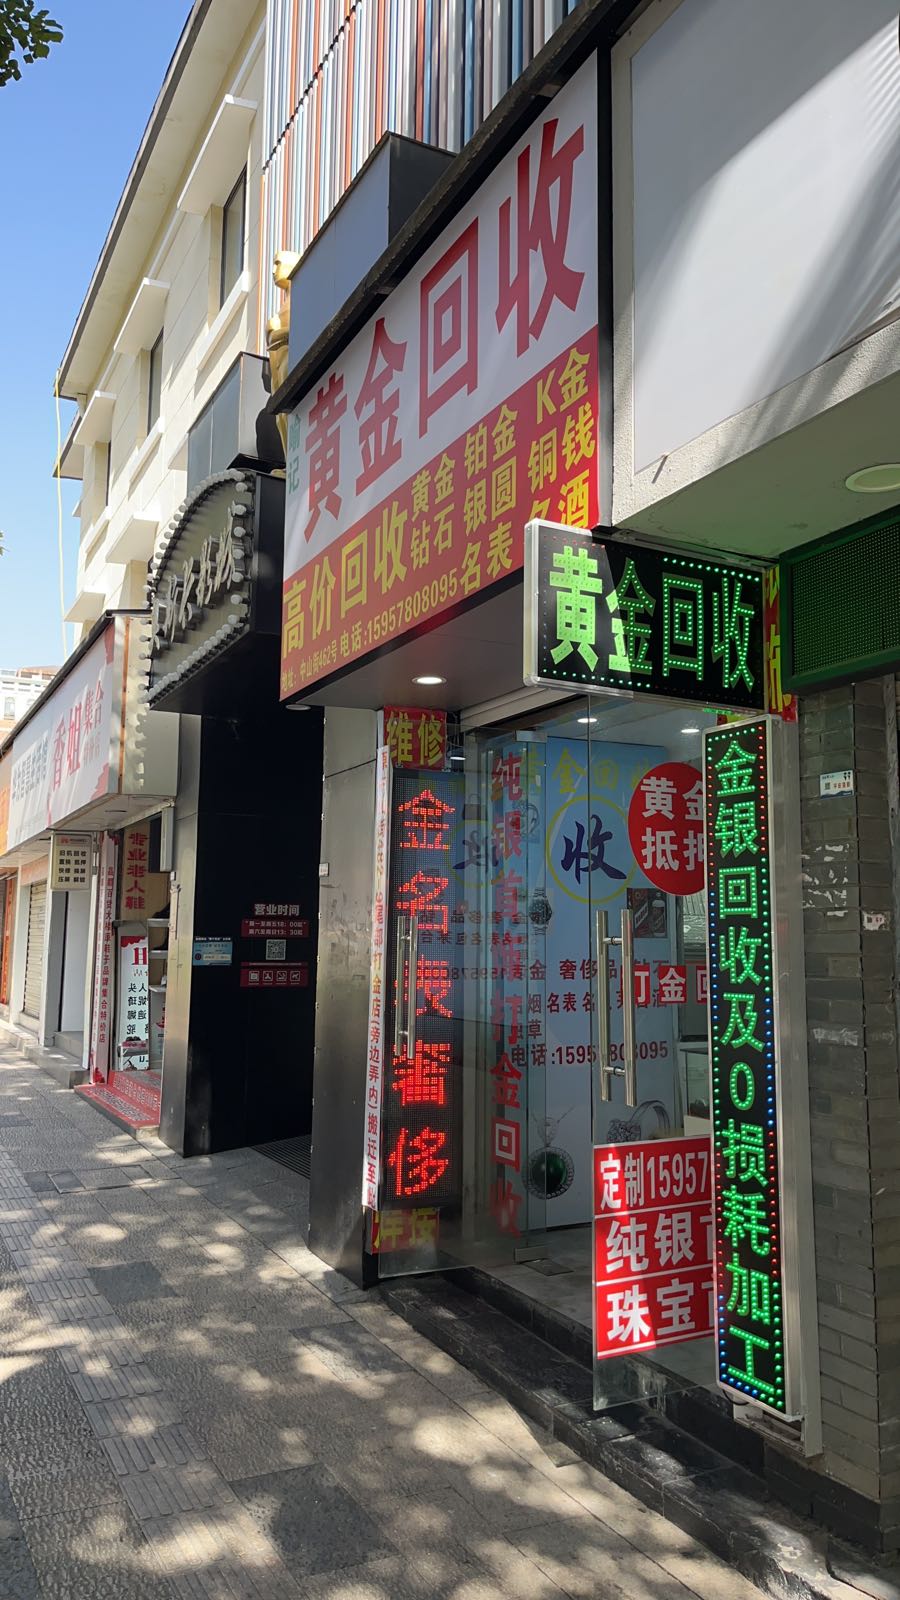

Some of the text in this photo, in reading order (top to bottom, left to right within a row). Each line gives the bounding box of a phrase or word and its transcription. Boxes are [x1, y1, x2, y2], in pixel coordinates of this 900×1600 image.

[304, 117, 586, 543] 黄金回收
[411, 347, 590, 522] 黄金 铂金 K金
[410, 401, 595, 572] 钻石 银圆 铜钱
[283, 501, 408, 659] 高价回收
[460, 521, 513, 595] 名表
[340, 568, 458, 658] 电话:15957808095
[549, 546, 755, 693] 黄金回收
[386, 711, 443, 767] 维修
[560, 814, 627, 884] 收
[254, 904, 300, 916] 营业时间
[546, 992, 577, 1013] 名表
